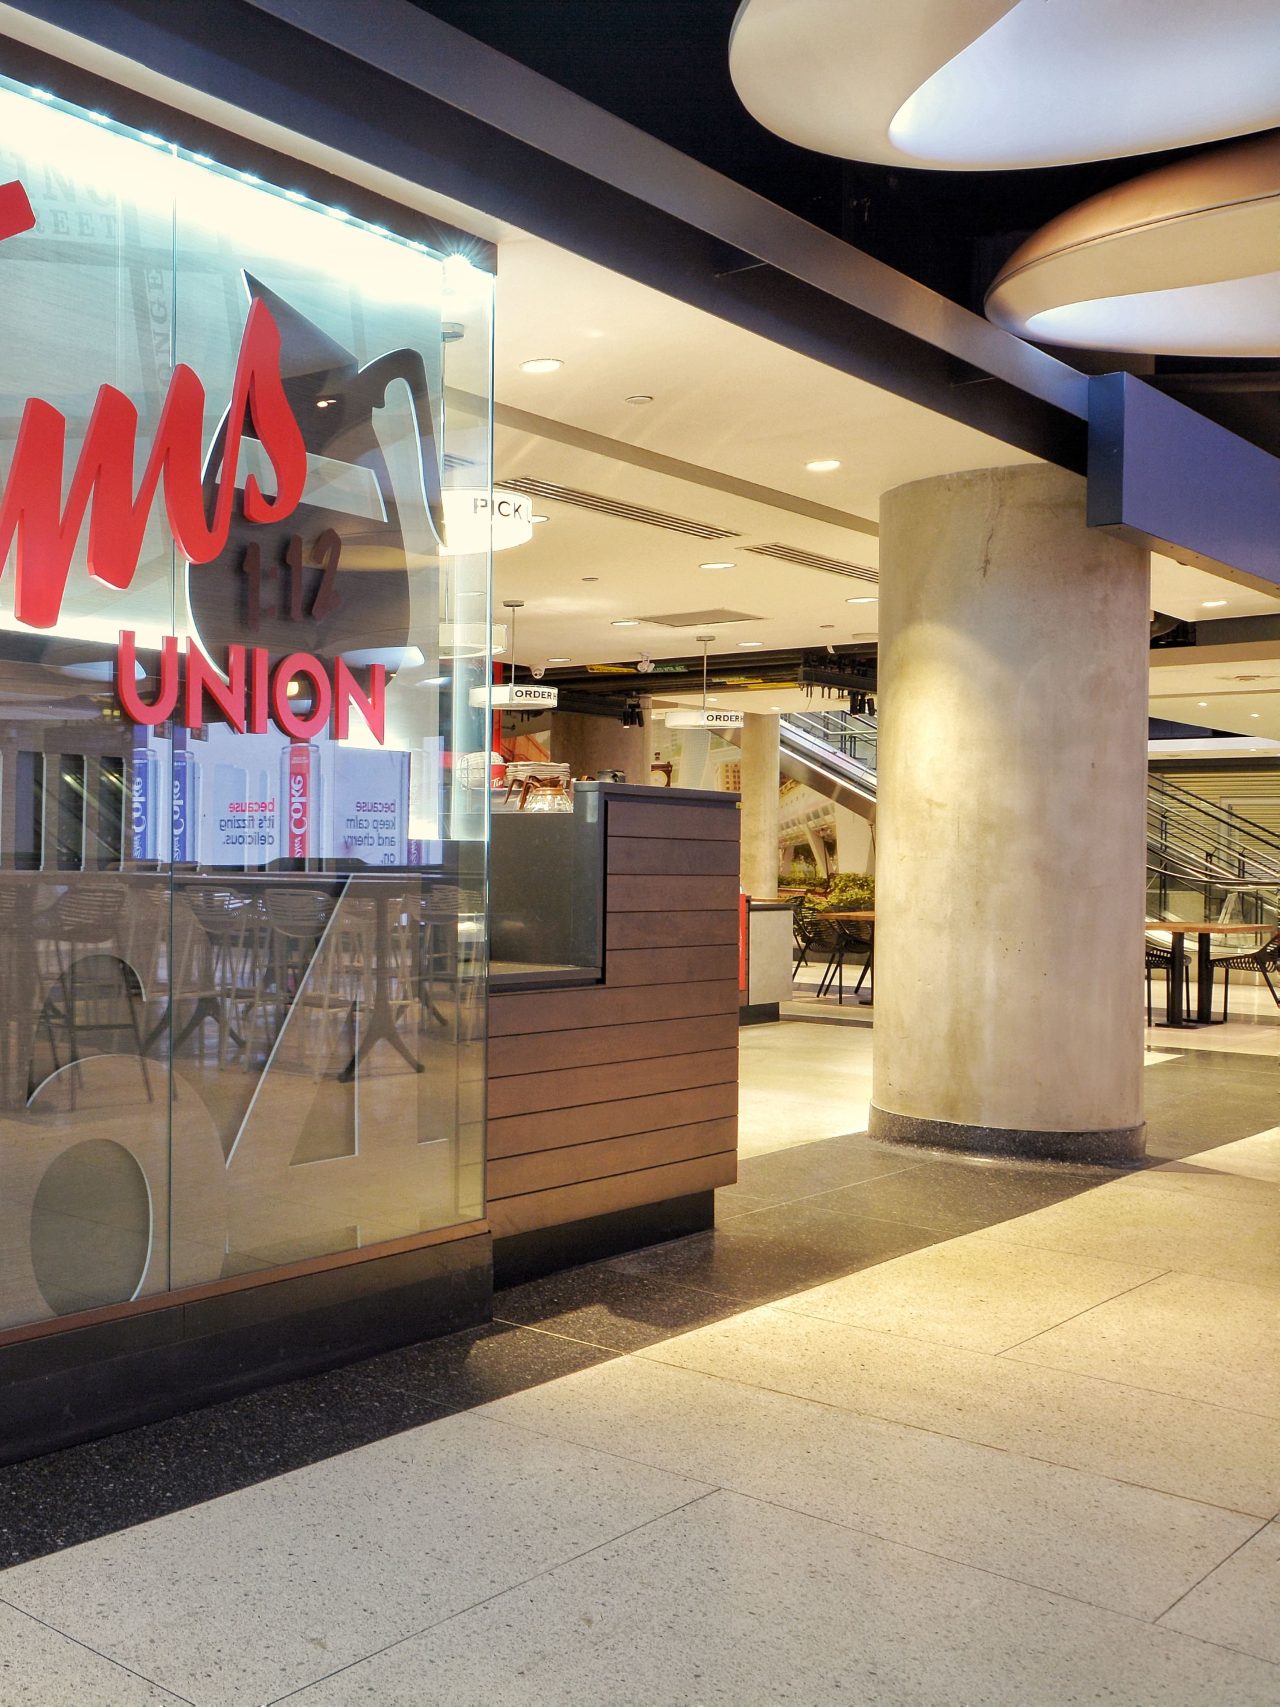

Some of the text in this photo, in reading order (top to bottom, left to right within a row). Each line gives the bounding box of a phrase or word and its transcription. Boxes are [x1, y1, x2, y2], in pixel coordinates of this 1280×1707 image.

[473, 497, 522, 520] PICK
[117, 630, 386, 745] UNION
[515, 689, 552, 700] ORDER
[706, 714, 740, 722] ORDER
